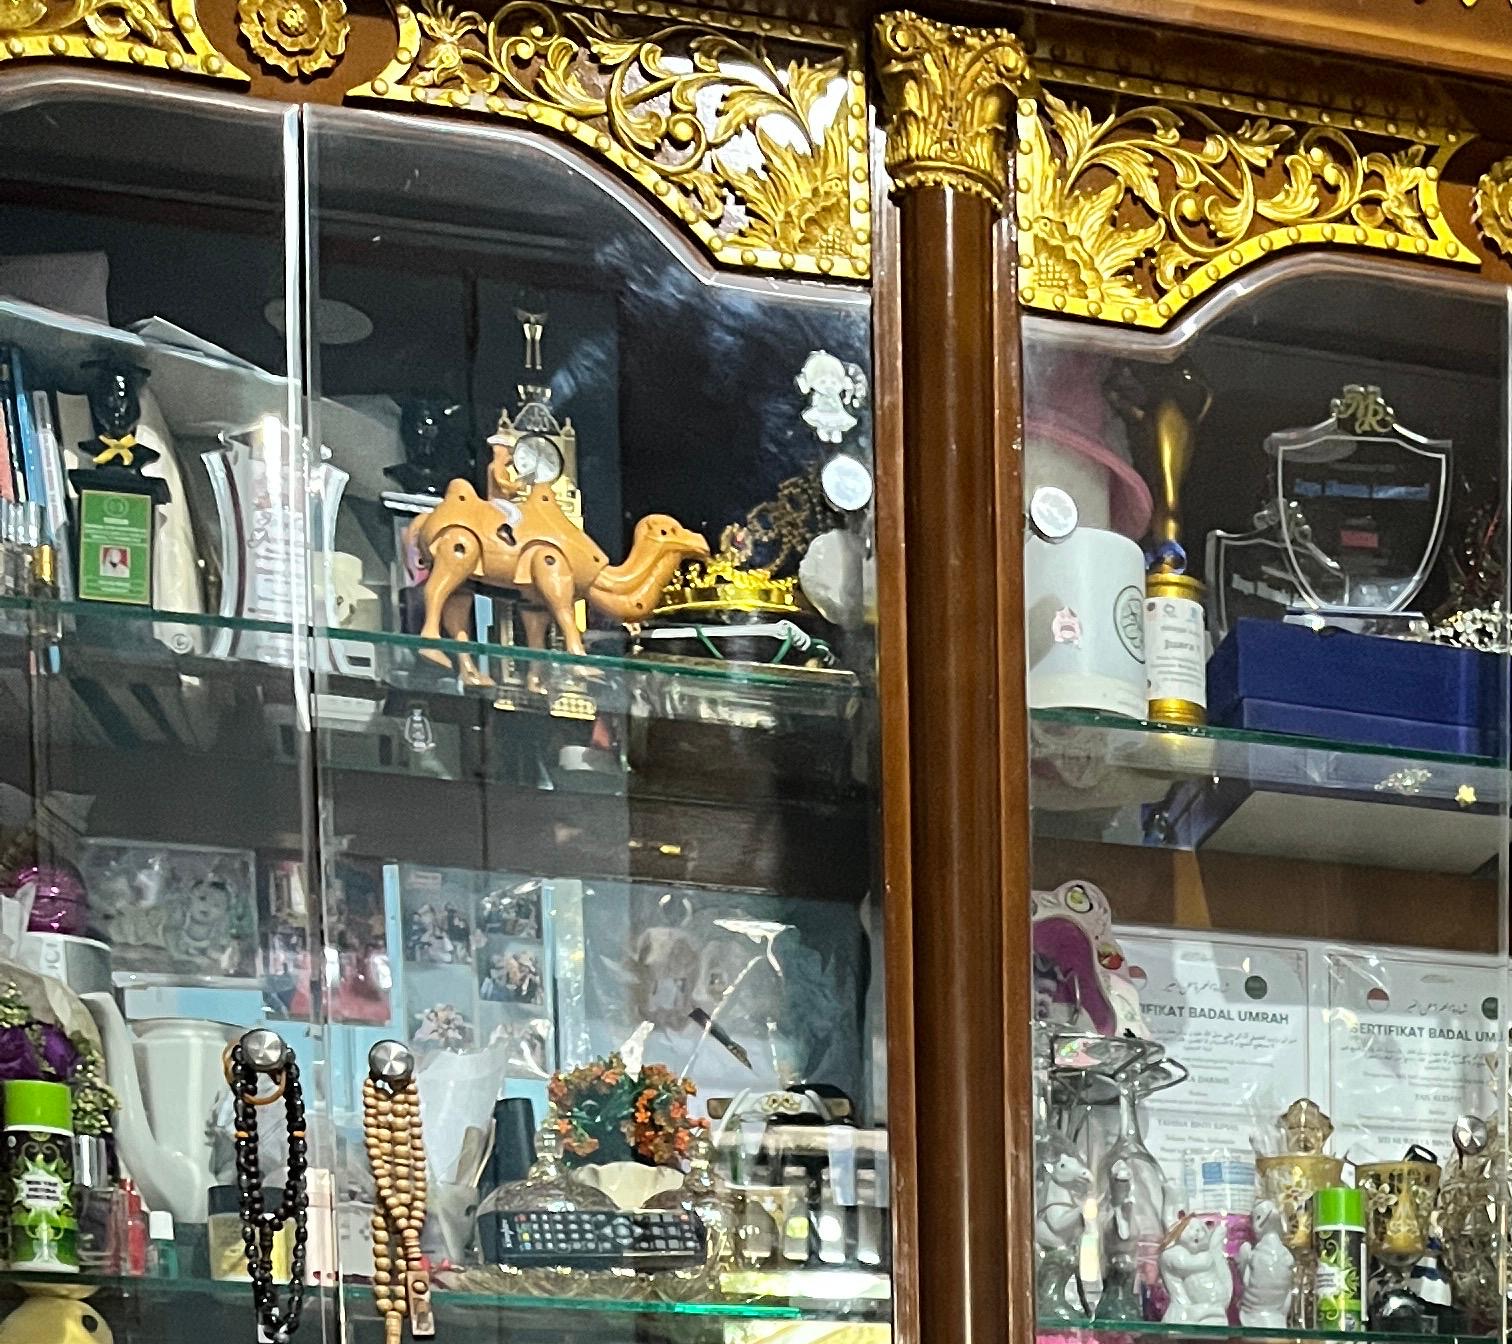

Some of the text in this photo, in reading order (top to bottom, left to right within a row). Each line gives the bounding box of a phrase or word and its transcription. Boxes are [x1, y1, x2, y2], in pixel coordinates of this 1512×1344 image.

[1188, 1006, 1235, 1022] BADAL
[1237, 1010, 1289, 1025] UMRAH
[1350, 1022, 1425, 1040] SERTIFIKAT
[1428, 1027, 1473, 1043] BADAL
